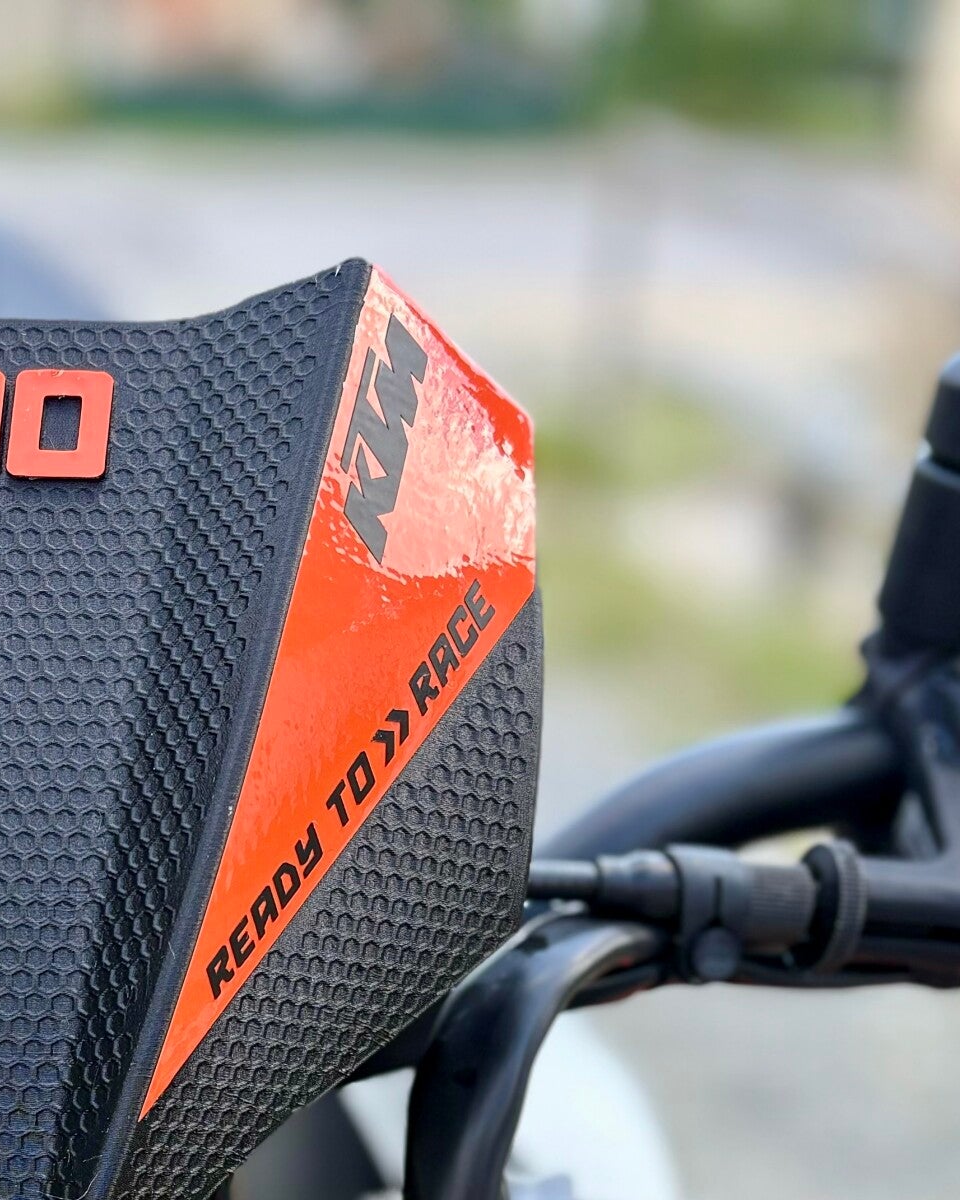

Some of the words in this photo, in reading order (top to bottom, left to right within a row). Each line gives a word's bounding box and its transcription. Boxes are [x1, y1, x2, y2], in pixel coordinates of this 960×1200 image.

[340, 312, 429, 565] KTM
[205, 823, 324, 1000] READY
[326, 751, 376, 828] TO
[408, 578, 496, 716] RACE
